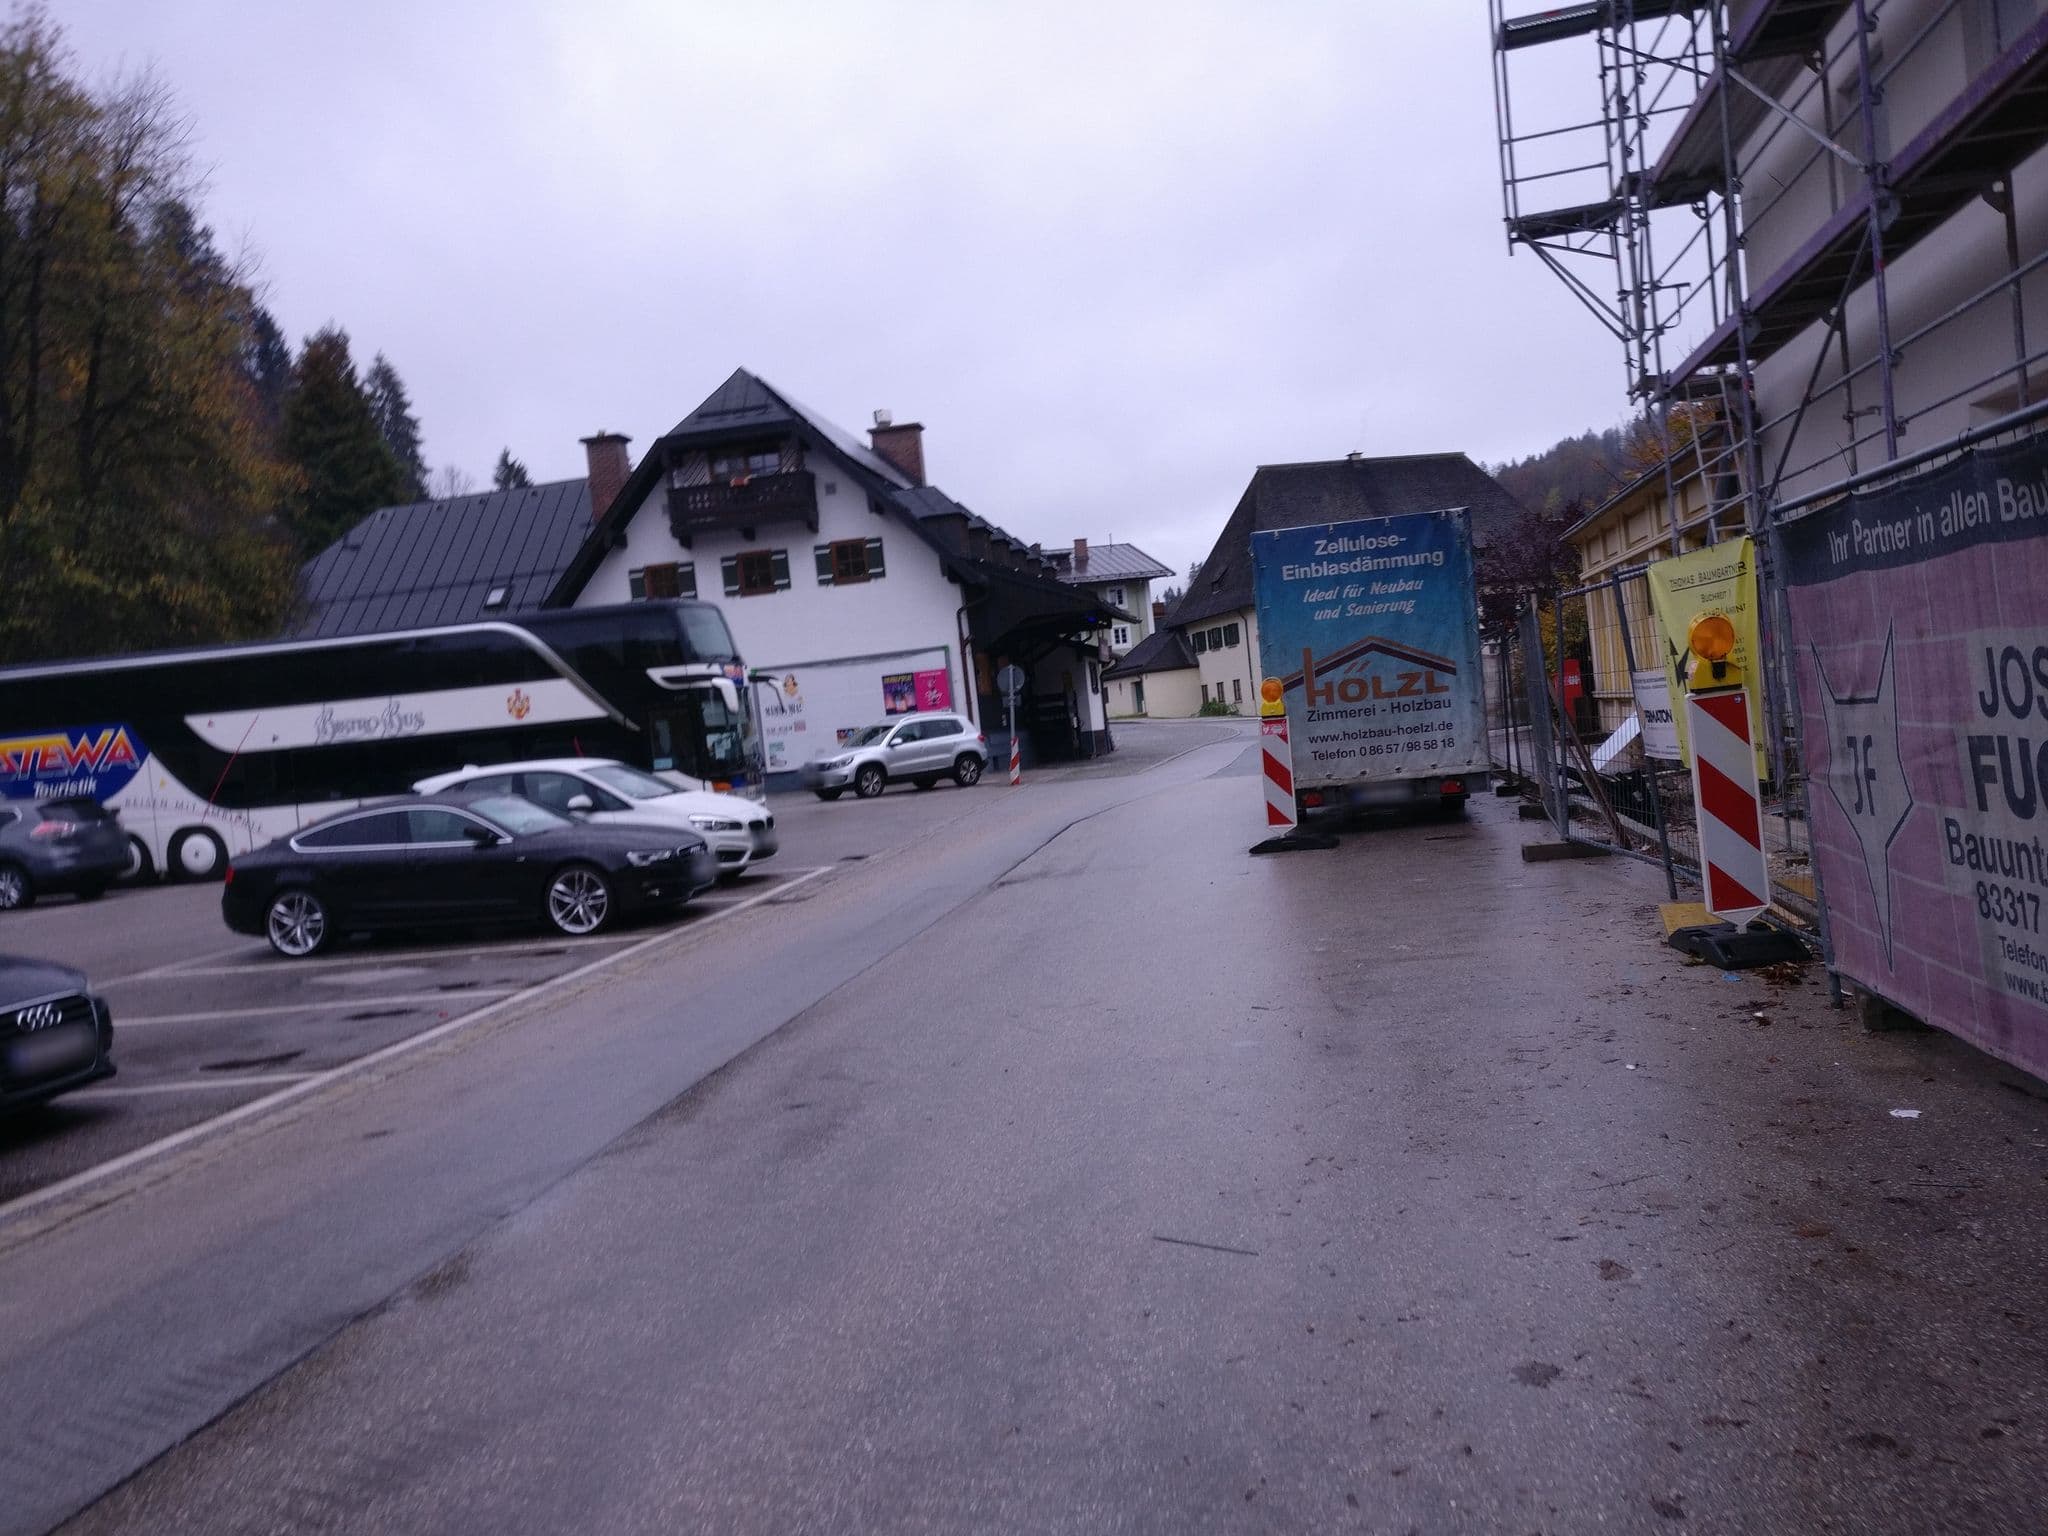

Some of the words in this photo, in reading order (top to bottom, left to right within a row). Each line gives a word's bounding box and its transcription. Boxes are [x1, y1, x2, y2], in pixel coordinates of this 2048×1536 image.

[1827, 530, 1849, 565] Ihr
[1852, 516, 1913, 555] Partner
[1915, 505, 1935, 544] in
[1940, 489, 1991, 536] allen
[1996, 467, 2048, 522] Bau
[1314, 534, 1407, 556] Zellulose-
[1282, 550, 1444, 581] Einblasdämmung
[1303, 587, 1338, 603] Ideal
[1343, 583, 1365, 599] für
[1370, 578, 1425, 595] Neubau
[1314, 605, 1340, 621] und
[1346, 598, 1417, 617] Sanierung
[1302, 647, 1450, 708] HÖLZL
[1306, 703, 1377, 723] Zimmerei
[1390, 698, 1452, 714] Holzbau
[1307, 720, 1454, 744] www.holzbau-hoelzl.de
[1311, 748, 1356, 761] Telefon
[33, 776, 98, 800] Touristik
[1944, 816, 2048, 889] Bauunt
[1975, 880, 2041, 935] 83317
[1998, 935, 2048, 975] Telefon
